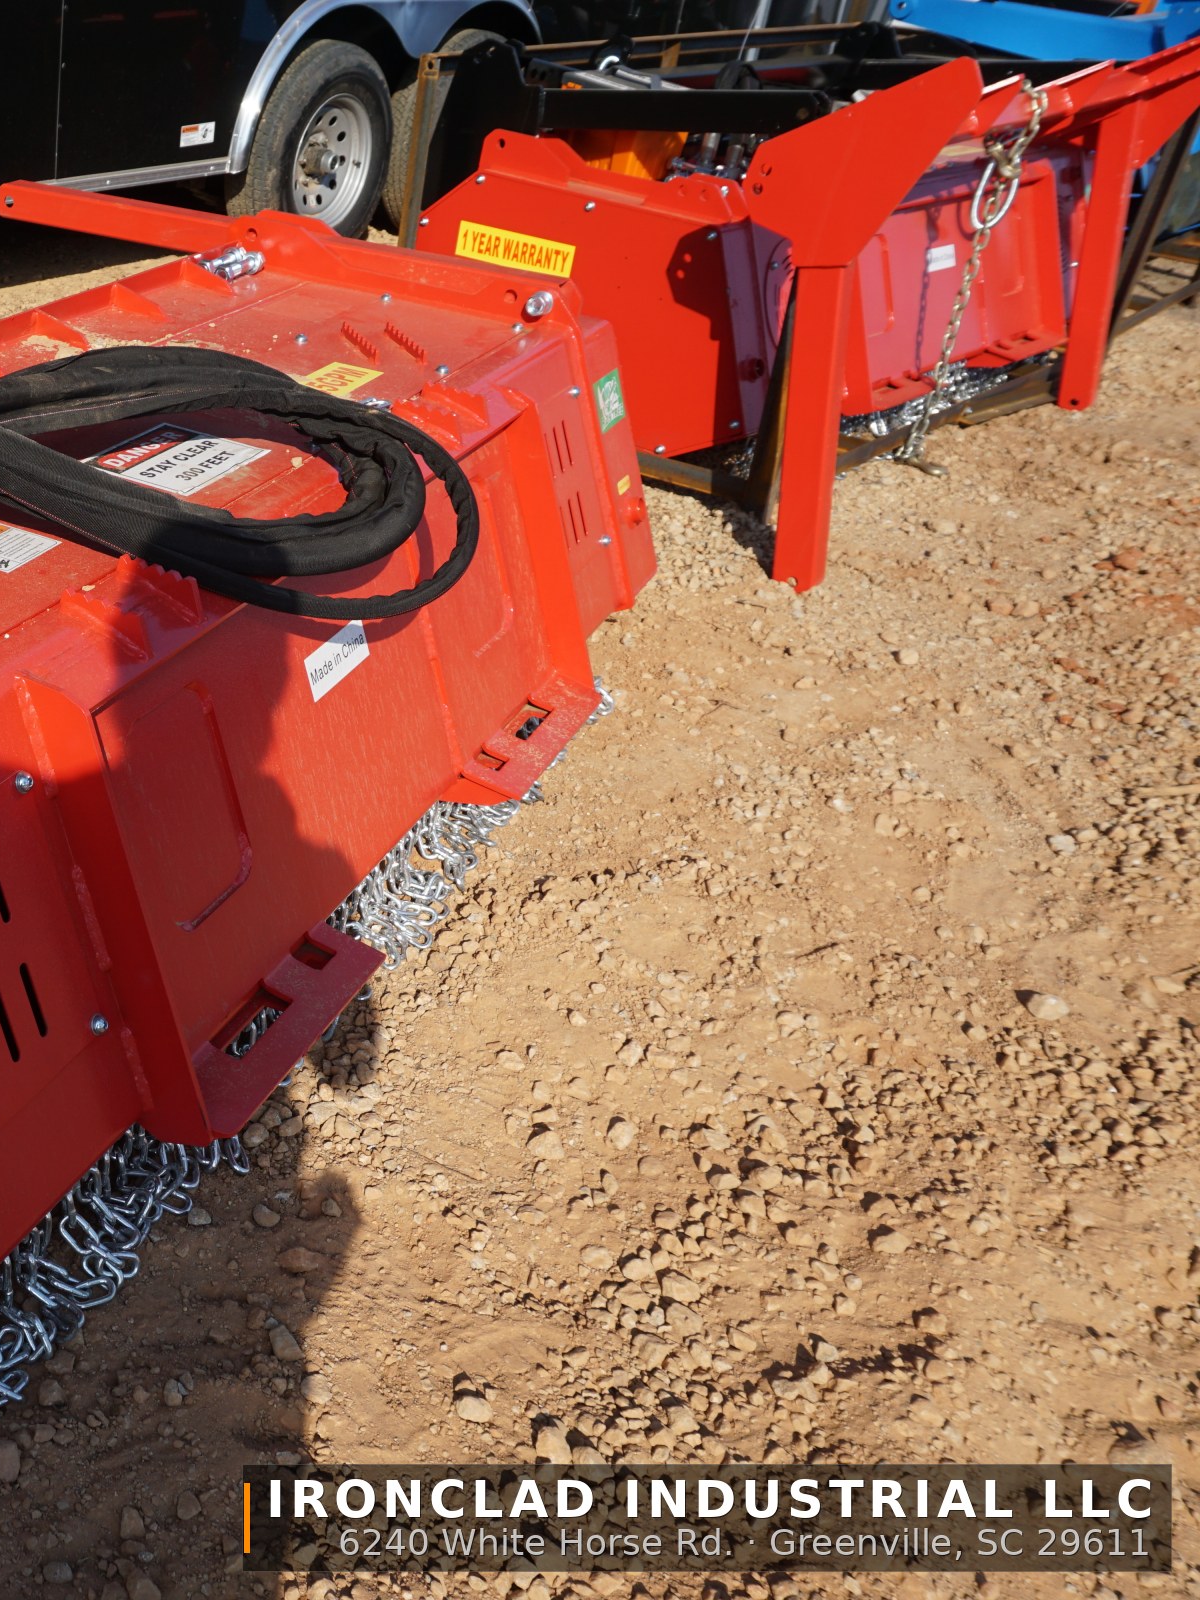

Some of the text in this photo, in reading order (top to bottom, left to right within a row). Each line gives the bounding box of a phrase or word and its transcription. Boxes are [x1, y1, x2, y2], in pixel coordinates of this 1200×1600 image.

[463, 229, 570, 273] 1 YEAR WARRANTY
[103, 431, 184, 468] DANGER
[139, 440, 219, 479] STAY CLEAR
[175, 450, 235, 481] 300 FEET
[310, 634, 365, 685] Made in China
